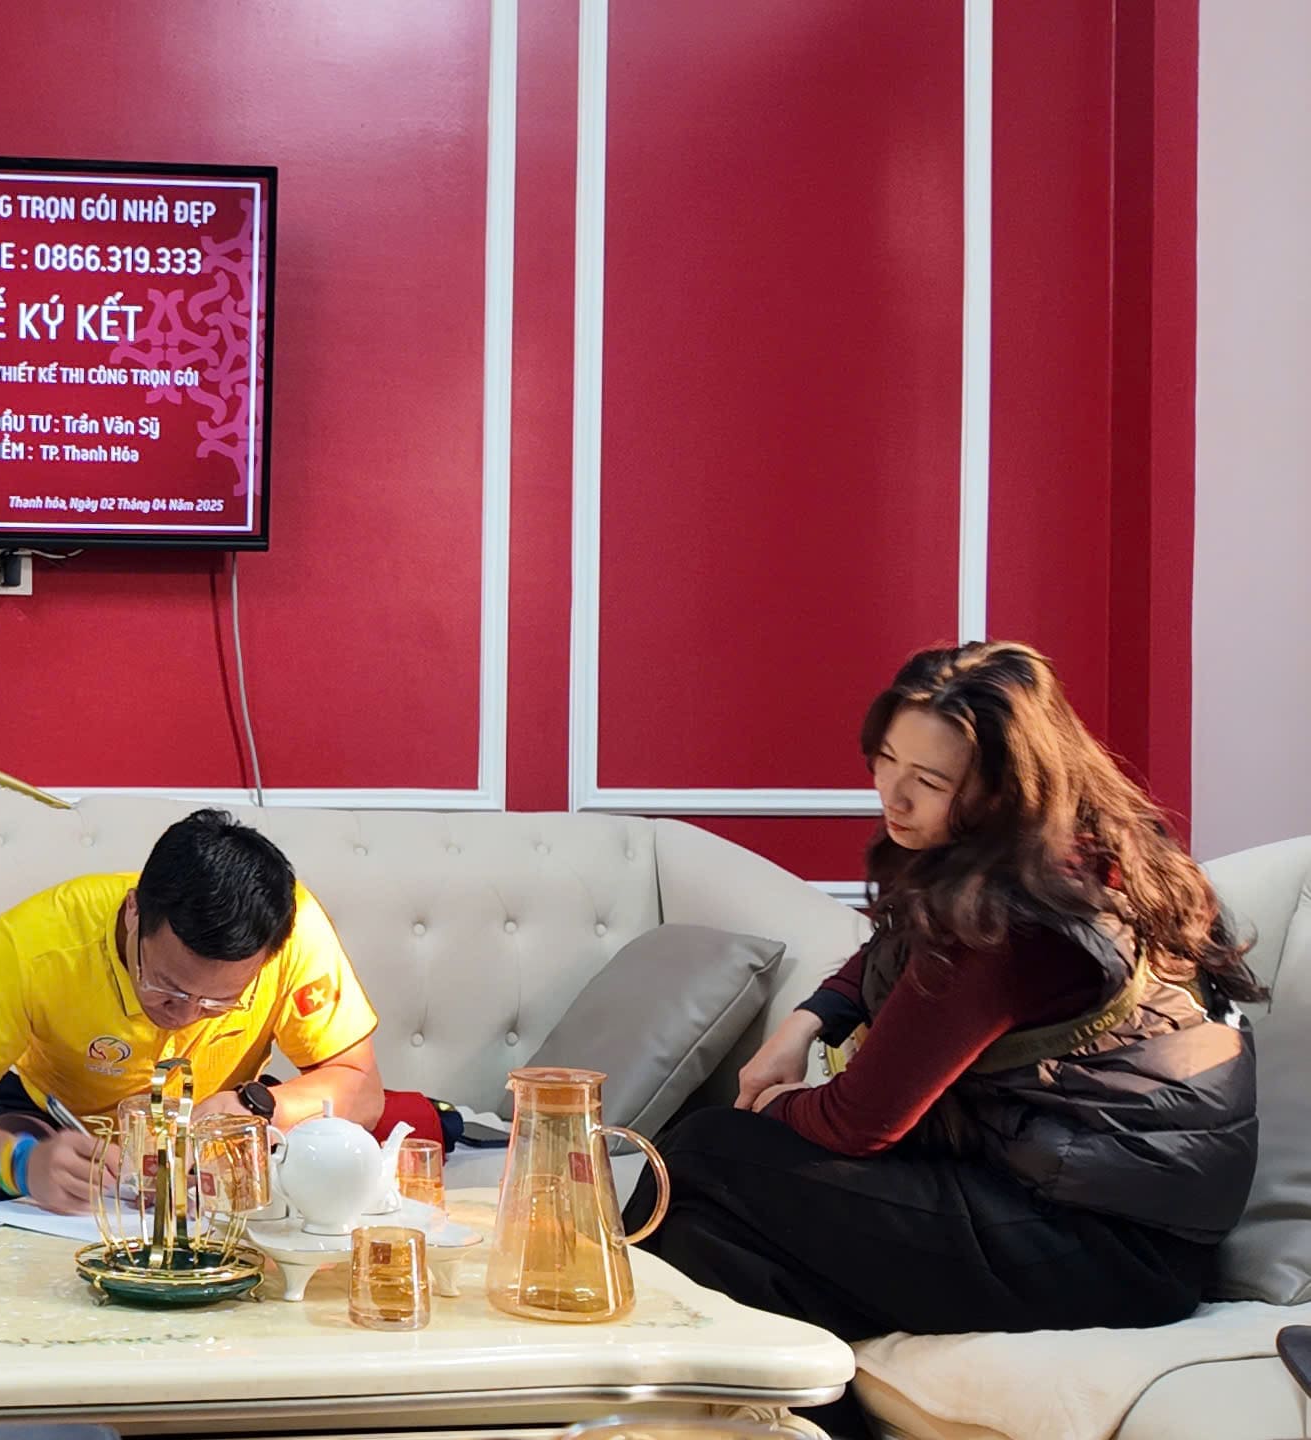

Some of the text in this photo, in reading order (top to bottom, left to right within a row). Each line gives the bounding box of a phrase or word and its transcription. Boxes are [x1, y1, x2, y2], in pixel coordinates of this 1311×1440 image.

[17, 196, 75, 223] TRỌN
[82, 194, 116, 221] GÓI
[123, 195, 168, 222] NHÀ
[174, 201, 216, 227] ĐẸP
[35, 244, 201, 274] 0866.319.333
[19, 295, 64, 339] KÝ
[77, 292, 143, 341] KẾT
[38, 362, 58, 383] KẾ
[60, 367, 84, 383] THI
[88, 365, 128, 384] CÔNG
[130, 369, 170, 388] TRỌN
[174, 367, 198, 386] GÓI
[28, 414, 52, 432] TƯ
[62, 413, 99, 433] Trần
[139, 417, 159, 439] Sỹ
[40, 445, 59, 460] TP.
[63, 445, 107, 461] Thanh
[111, 446, 139, 462] Hóa
[9, 496, 44, 509] Thanh
[100, 498, 115, 510] 02
[152, 498, 166, 510] 04
[196, 499, 223, 511] 2025
